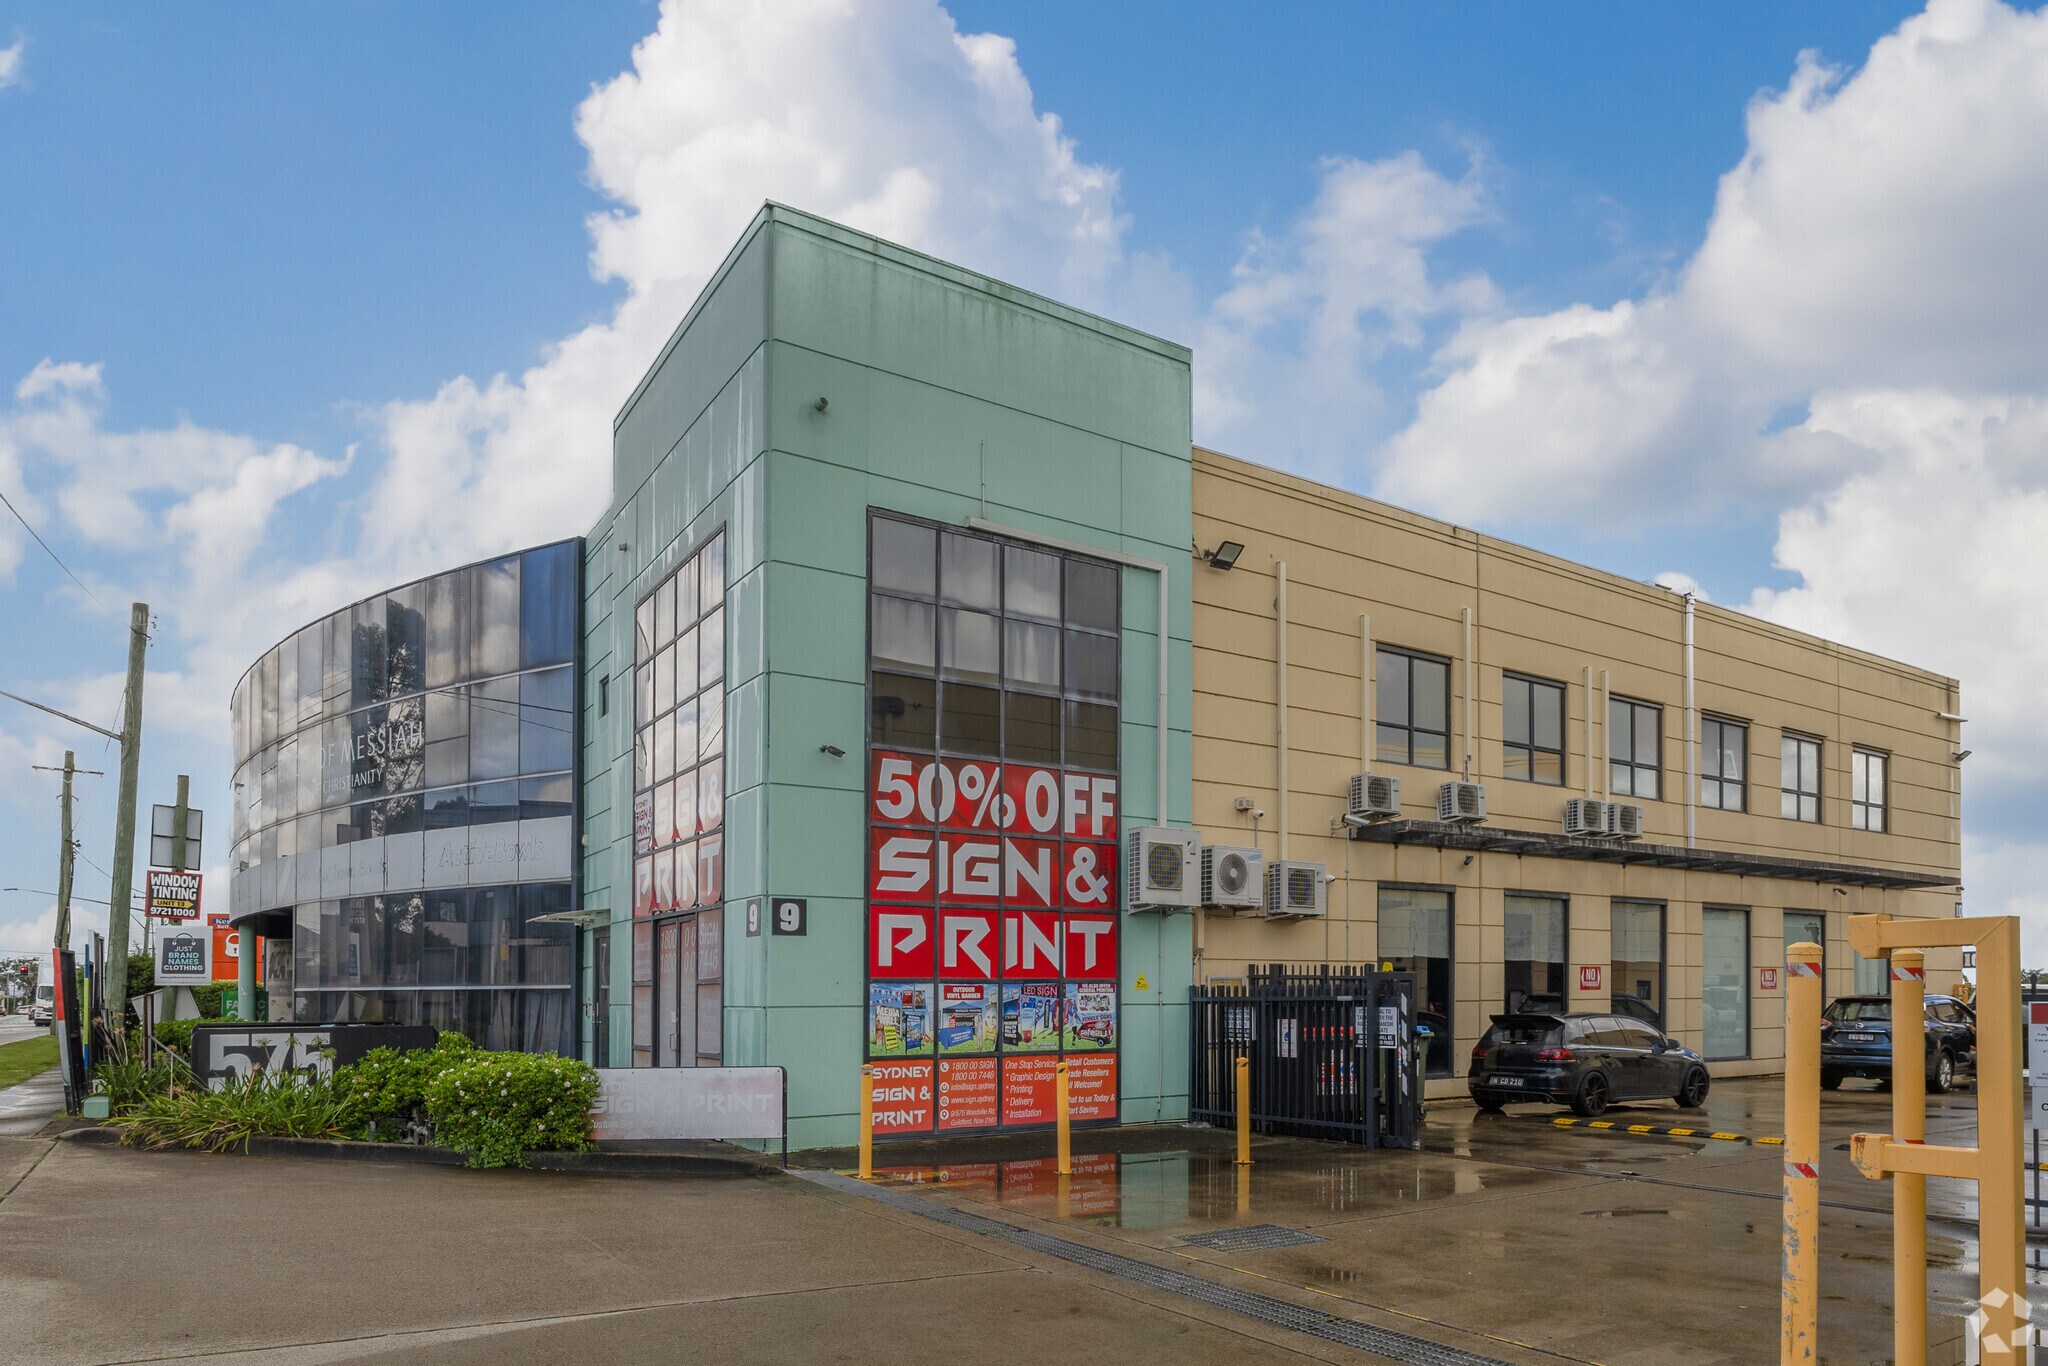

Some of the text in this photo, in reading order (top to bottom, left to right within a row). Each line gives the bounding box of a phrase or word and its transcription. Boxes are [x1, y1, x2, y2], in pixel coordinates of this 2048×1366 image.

[340, 721, 423, 763] MESSIAH
[323, 768, 383, 794] CHRISTIANITY
[876, 758, 1117, 836] 50% OFF
[635, 840, 722, 908] PRINT
[876, 837, 1108, 907] SIGN &
[150, 873, 199, 888] WINDOW
[152, 886, 197, 900] TINTING
[749, 904, 758, 932] 9
[779, 903, 801, 932] 9
[699, 922, 719, 946] SIGN
[878, 912, 1113, 978] PRINT
[699, 948, 719, 970] 7446
[1585, 968, 1596, 980] NO
[1023, 985, 1058, 997] LED SIGN
[876, 1005, 900, 1018] MEDIA
[208, 1032, 333, 1095] 575
[952, 1060, 995, 1071] 1800 00 SIGN
[1006, 1061, 1018, 1069] One
[1020, 1060, 1033, 1069] Stop
[1065, 1057, 1114, 1066] Retail Customers
[872, 1066, 931, 1079] SYDNEY
[951, 1071, 995, 1081] 1800 00 7446
[1010, 1071, 1055, 1082] Graphic Design
[1067, 1068, 1110, 1077] rade Resellers
[951, 1081, 995, 1092] info@sign.sydney
[1010, 1085, 1033, 1095] Printing
[1074, 1080, 1103, 1089] Welcome!
[872, 1086, 931, 1102] SIGN &
[951, 1095, 995, 1105] www.sign.sydney
[1068, 1095, 1079, 1103] hat
[1079, 1095, 1085, 1103] to
[1094, 1094, 1109, 1103] Today
[588, 1095, 655, 1114] SIGN
[687, 1092, 775, 1115] PRINT
[1010, 1097, 1034, 1107] Delivery
[872, 1109, 927, 1127] PRINT
[984, 1116, 997, 1124] 2161
[1010, 1108, 1042, 1119] Installation
